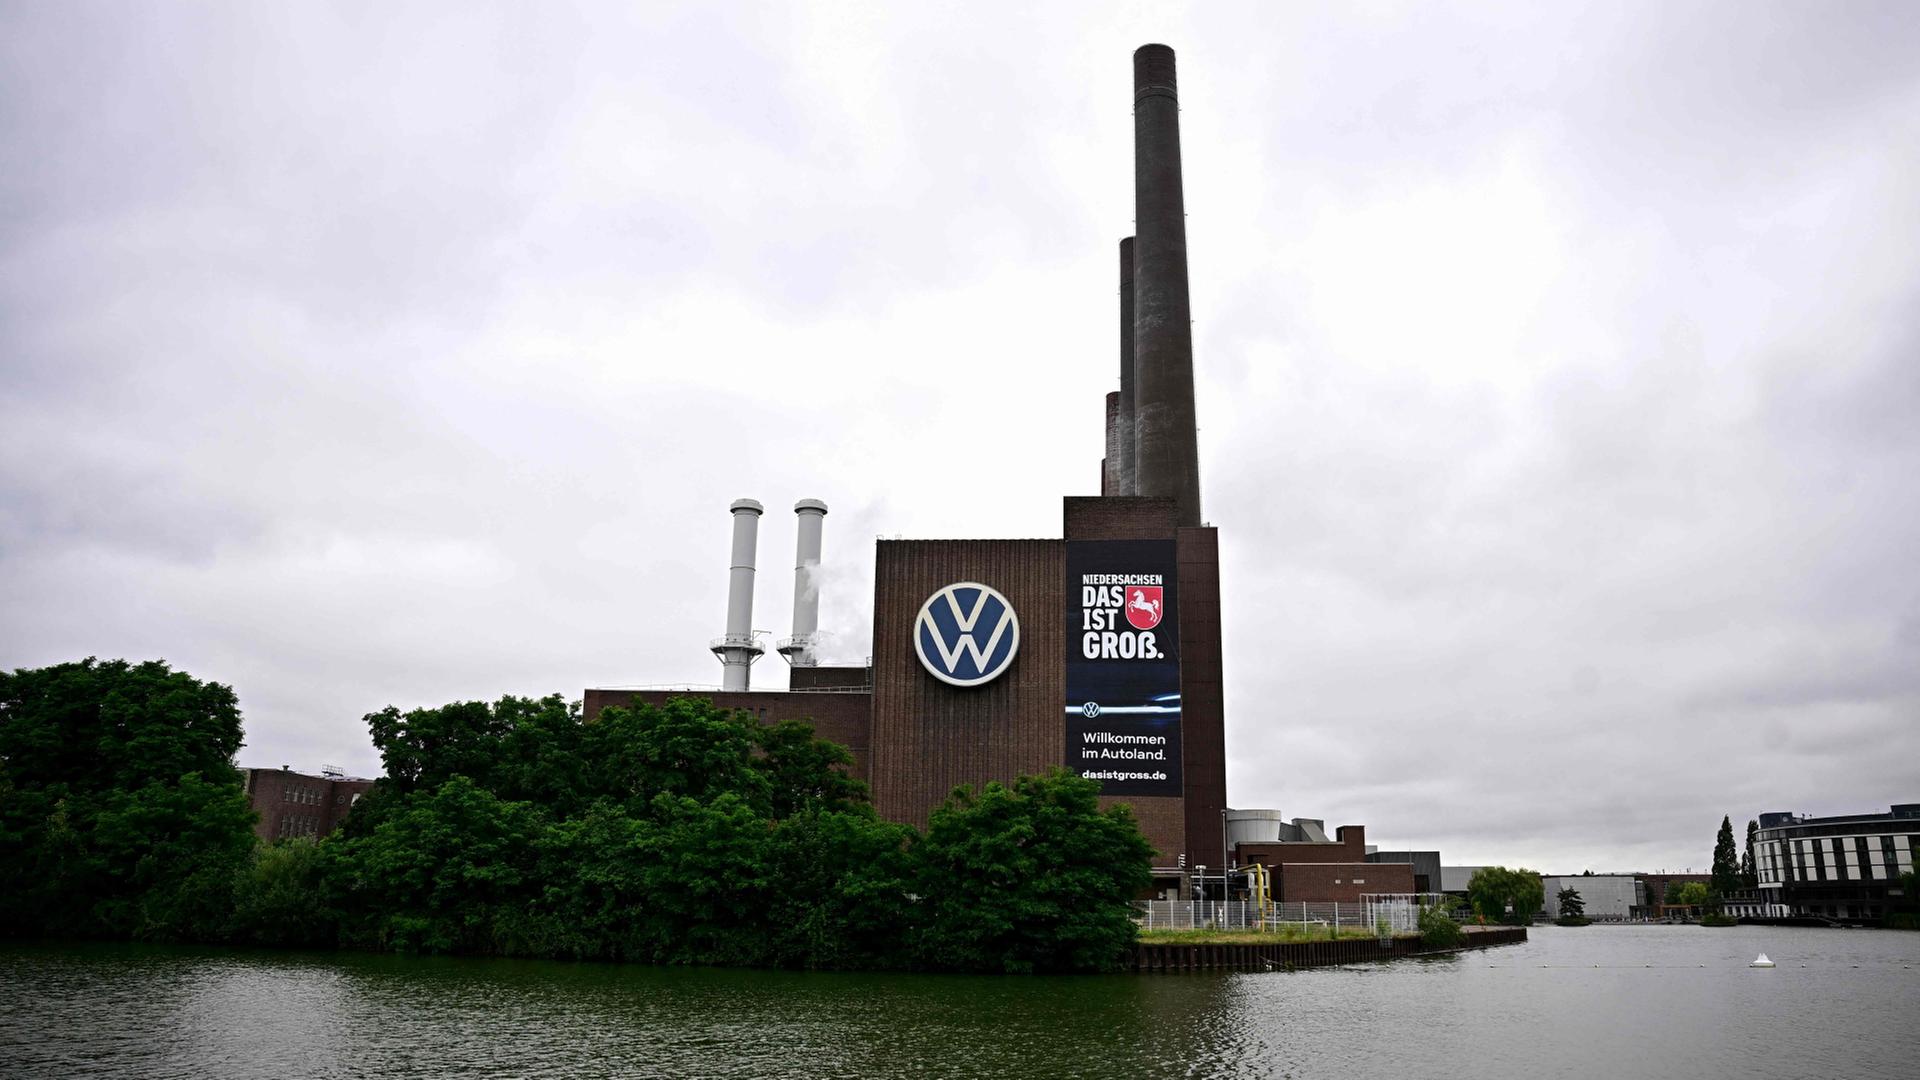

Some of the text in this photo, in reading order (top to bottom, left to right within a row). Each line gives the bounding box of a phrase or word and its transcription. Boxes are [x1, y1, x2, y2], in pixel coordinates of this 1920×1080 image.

[1083, 574, 1163, 585] NIEDERSACHSEN
[1083, 585, 1125, 608] DAS
[1083, 608, 1119, 631] IST
[918, 586, 1015, 676] VW
[1083, 732, 1166, 745] Willkommen
[1082, 747, 1167, 760] im Autoland.
[1082, 769, 1167, 781] dasistgross.de
